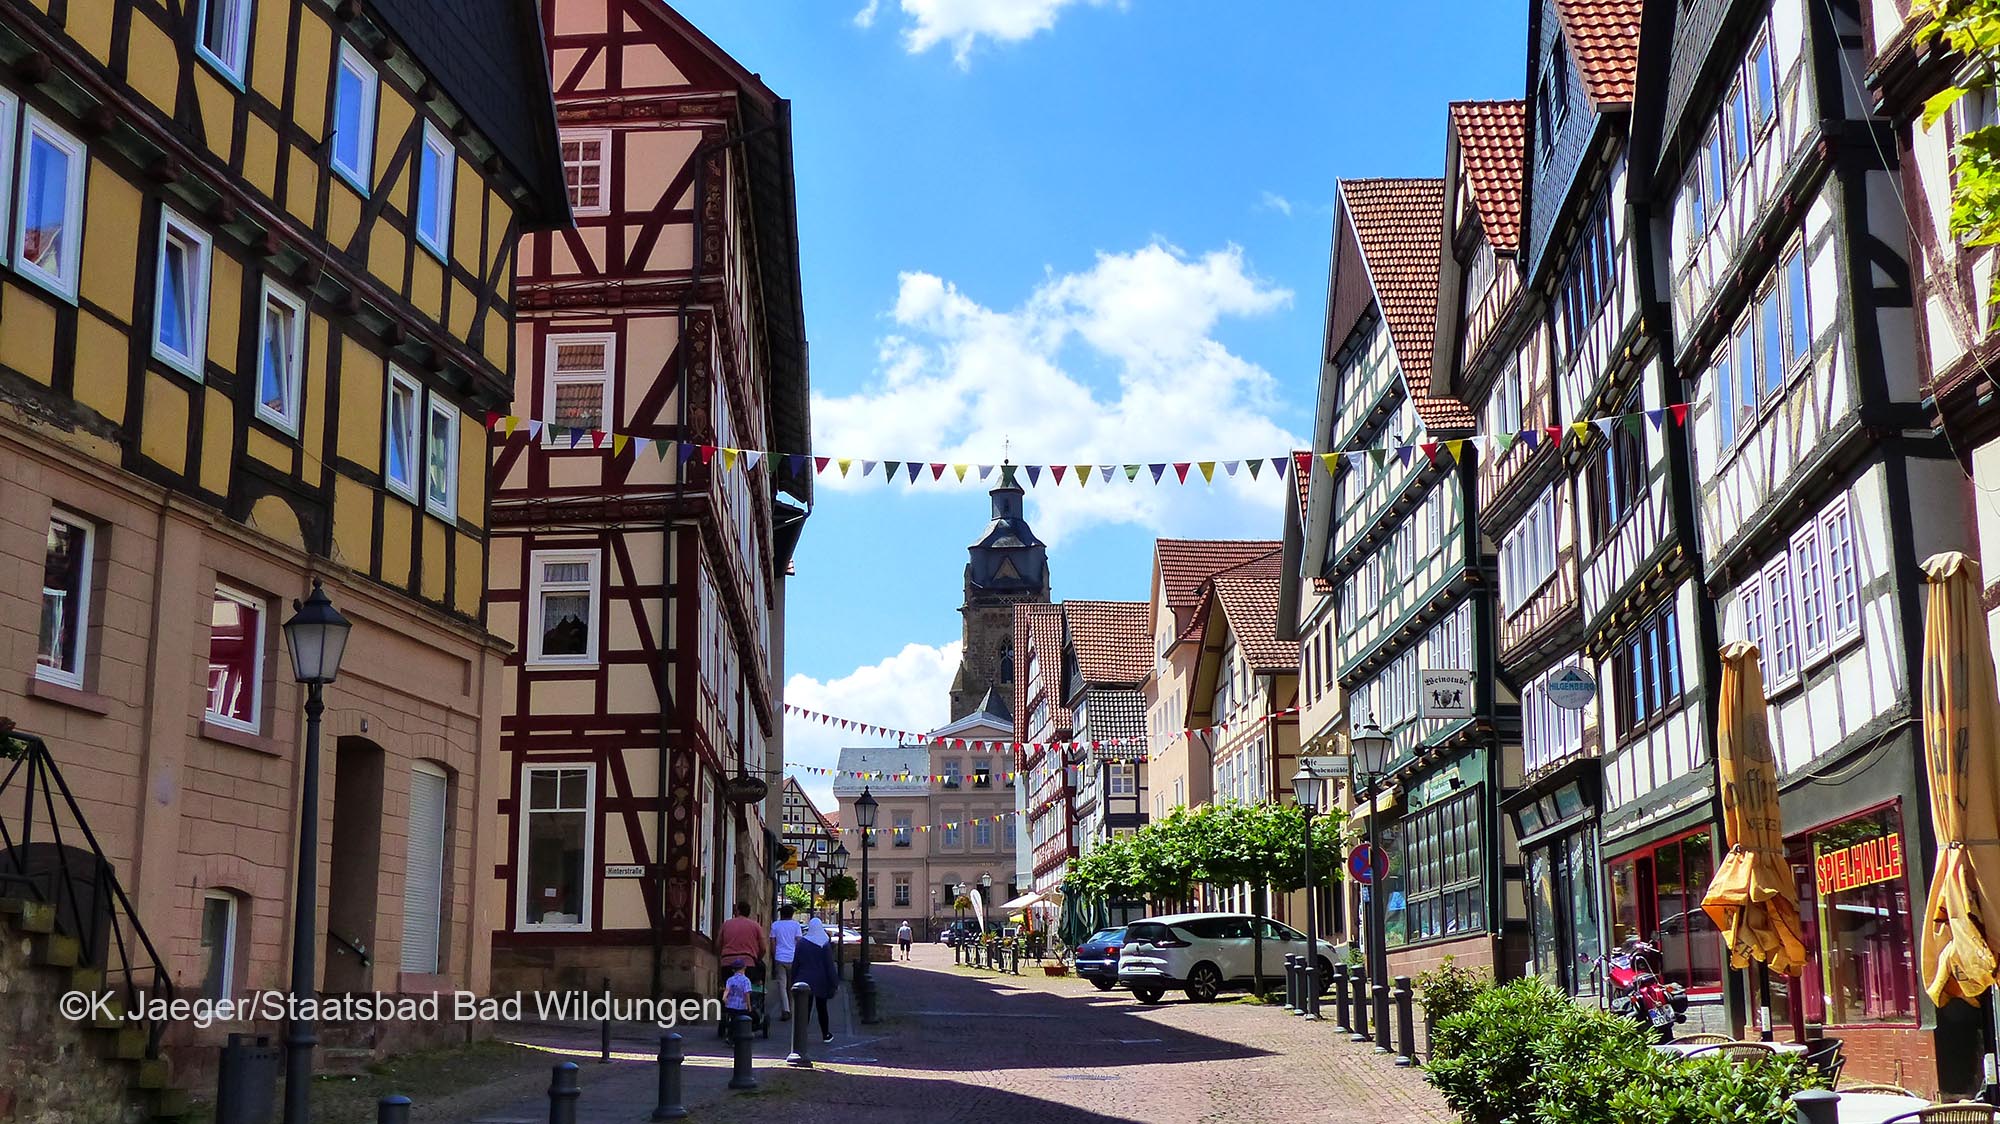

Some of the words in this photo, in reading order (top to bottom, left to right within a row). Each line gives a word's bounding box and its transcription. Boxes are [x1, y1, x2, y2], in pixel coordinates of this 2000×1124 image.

[1424, 676, 1468, 686] Weinstube
[1549, 682, 1596, 691] HILGENBERG
[1816, 833, 1902, 895] SPIELHALLE
[607, 867, 643, 875] Hinterstraße
